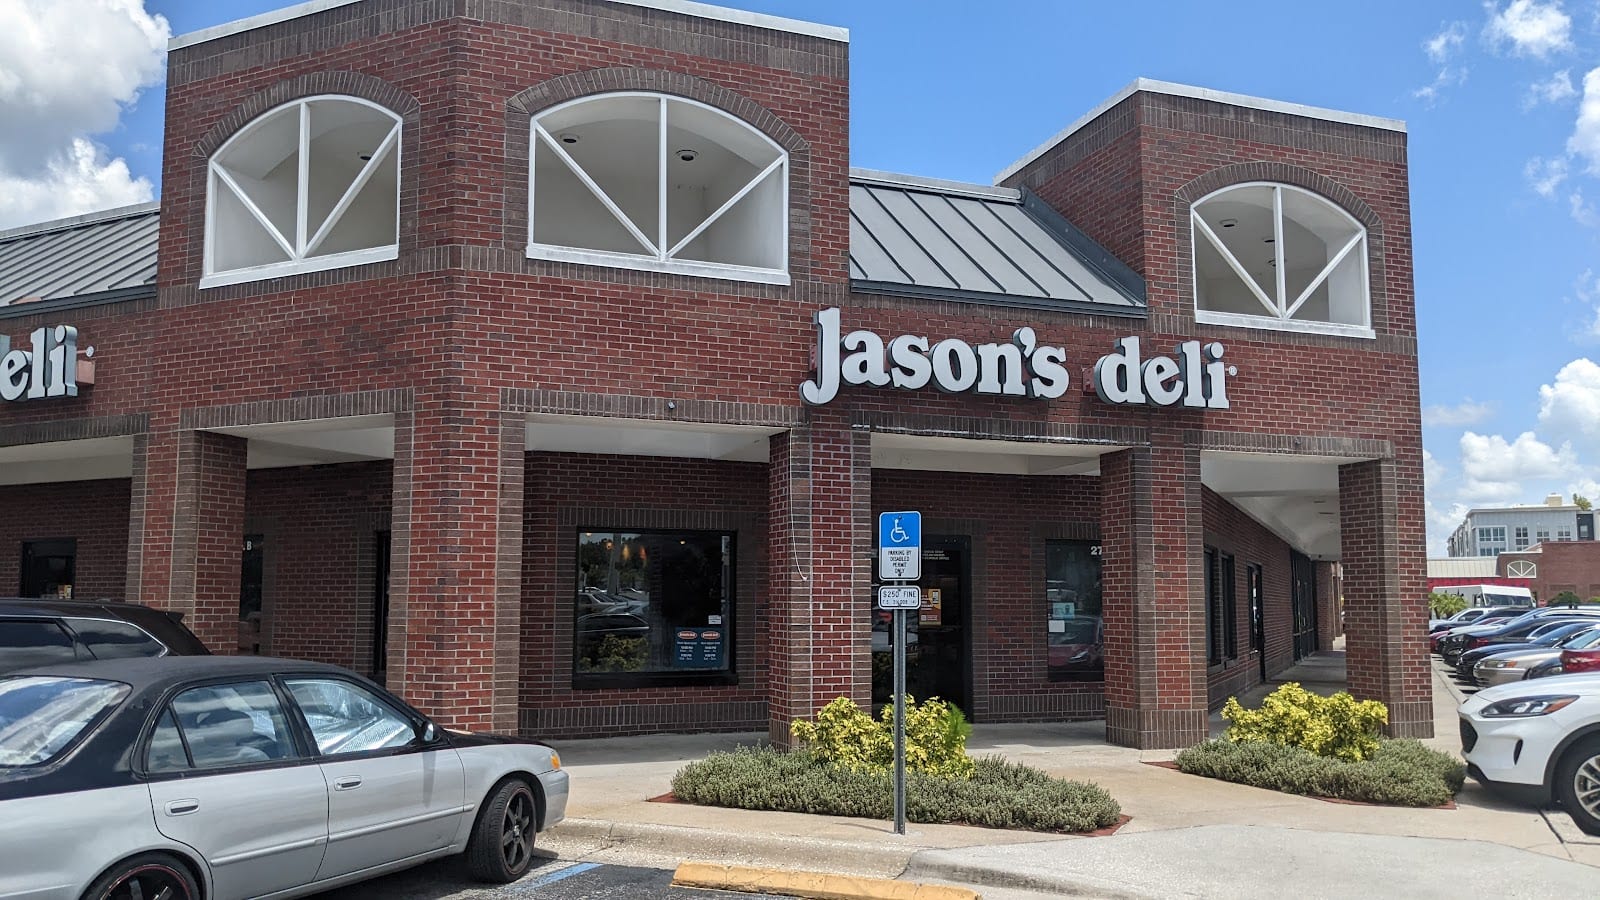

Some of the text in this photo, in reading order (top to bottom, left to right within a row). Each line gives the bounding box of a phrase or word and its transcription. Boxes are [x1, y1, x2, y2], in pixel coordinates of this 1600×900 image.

[0, 325, 77, 401] eli
[800, 306, 1230, 409] Jason's deli
[882, 590, 917, 598] $250 FINE
